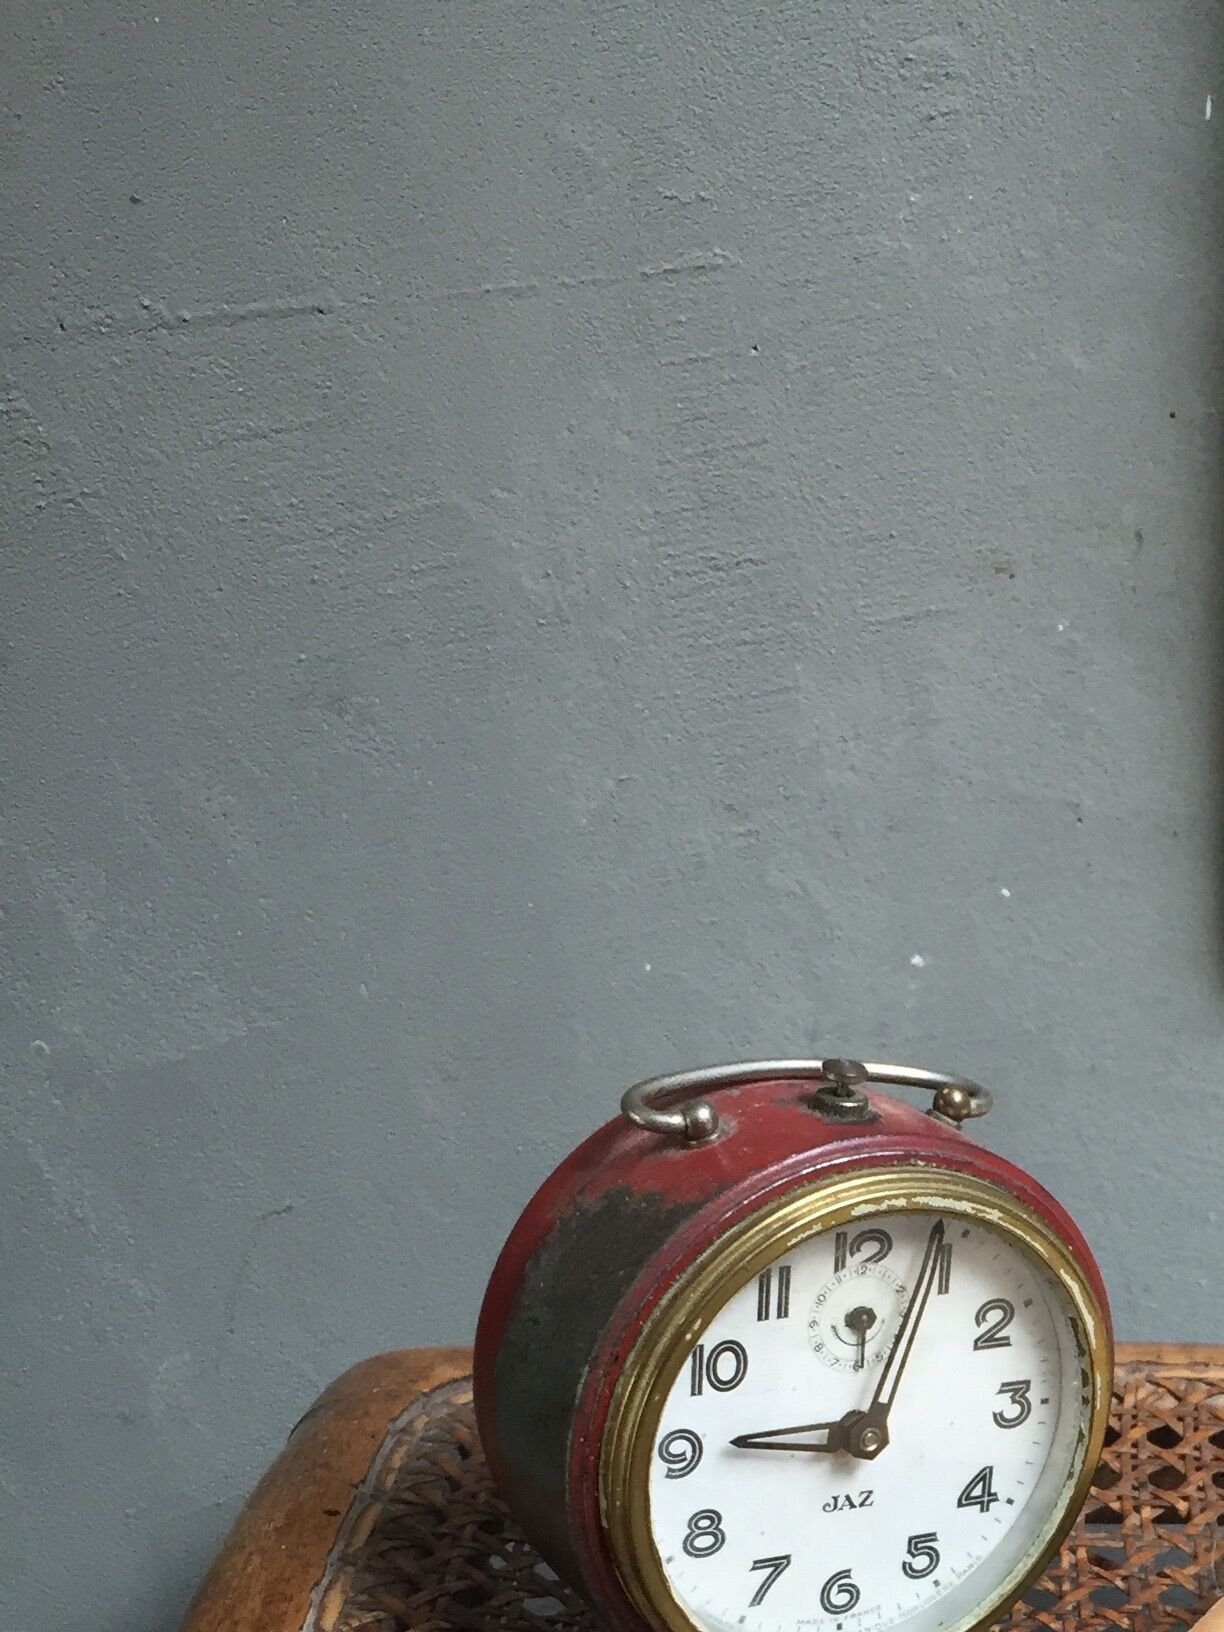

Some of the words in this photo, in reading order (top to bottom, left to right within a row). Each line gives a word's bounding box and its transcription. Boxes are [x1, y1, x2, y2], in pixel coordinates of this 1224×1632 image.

[834, 1228, 893, 1276] 12
[757, 1265, 792, 1321] 11
[973, 1298, 1016, 1351] 2
[690, 1338, 748, 1396] 10
[992, 1379, 1032, 1429] 3
[658, 1428, 704, 1479] 9
[822, 1490, 874, 1513] JAZ
[957, 1465, 1000, 1513] 4
[682, 1508, 726, 1558] 8
[901, 1532, 940, 1580] 5
[748, 1554, 792, 1607] 7
[819, 1568, 861, 1615] 6
